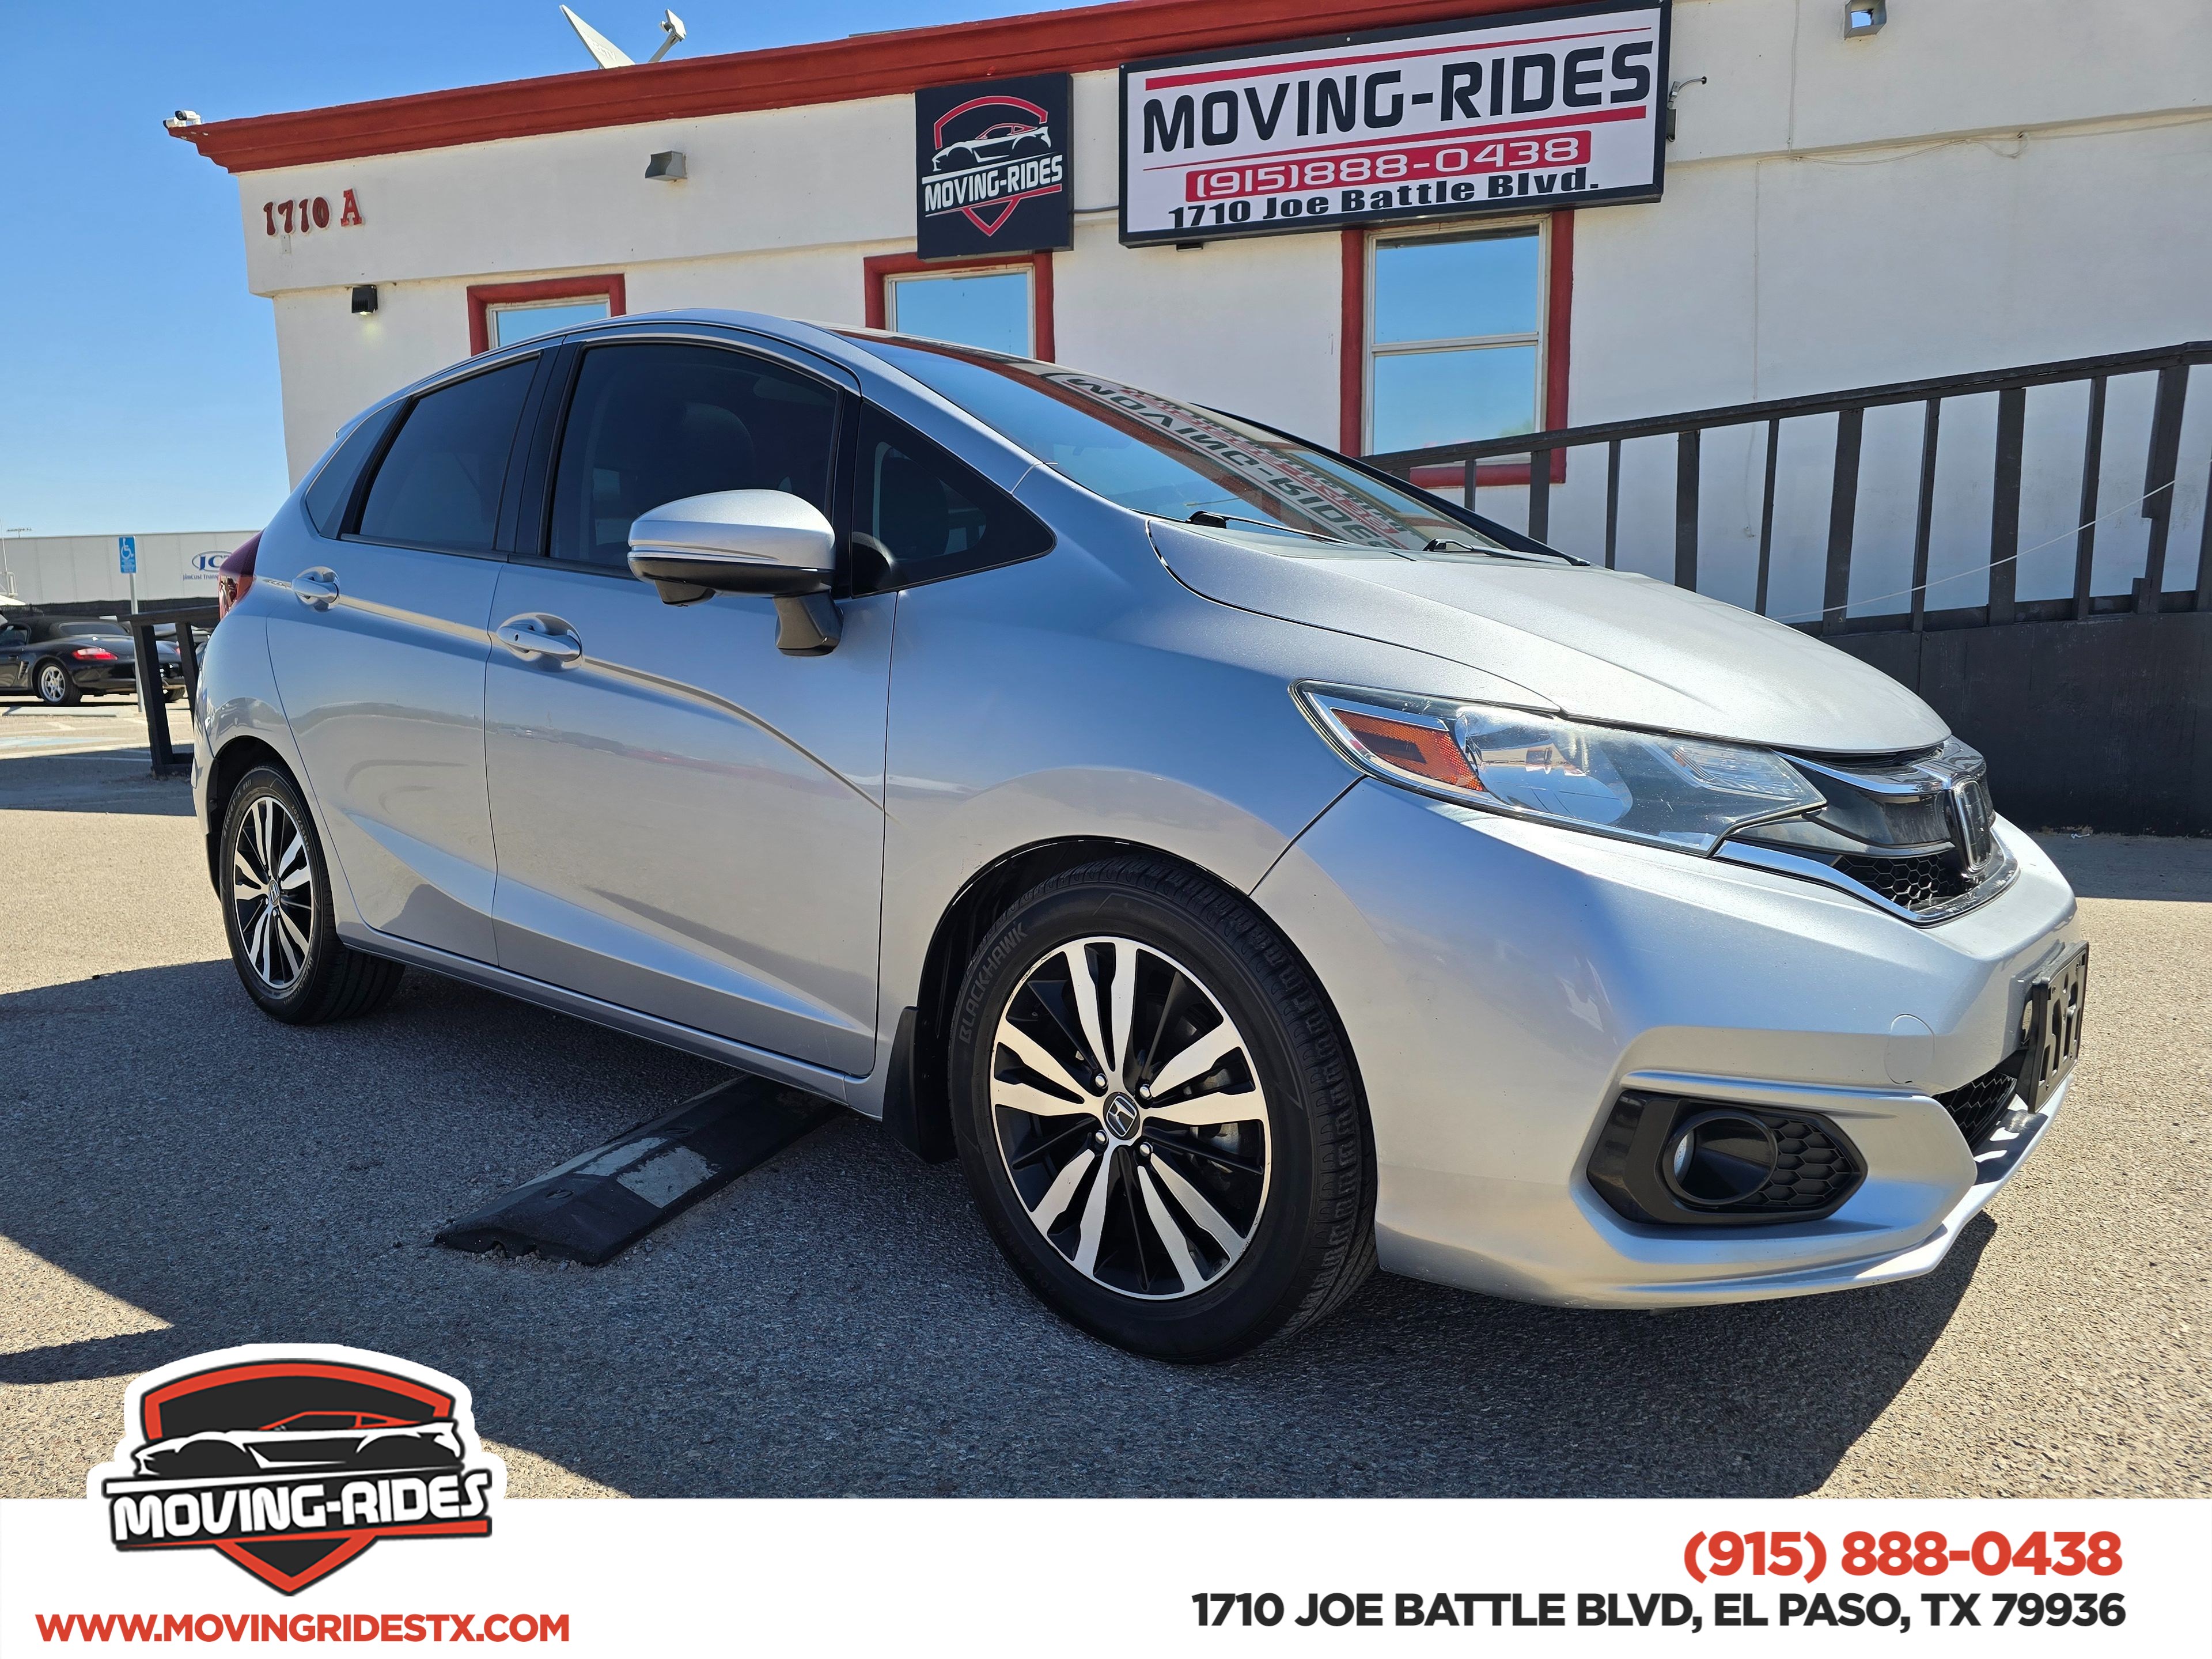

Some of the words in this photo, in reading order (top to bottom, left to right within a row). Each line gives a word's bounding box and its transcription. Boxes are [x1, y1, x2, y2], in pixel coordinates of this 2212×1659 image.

[1143, 41, 1653, 153] MOVING-RIDES
[925, 155, 1062, 211] MOVING-RIDES
[1169, 200, 1251, 228] 1710
[1263, 196, 1328, 219] Joe
[1342, 180, 1475, 212] Battle
[1488, 167, 1599, 198] Blvd.
[1196, 137, 1578, 198] (915)888-0438
[263, 196, 329, 236] 1710
[340, 188, 362, 227] A
[199, 555, 230, 570] JC
[959, 922, 1028, 1044] BLACKHAWK
